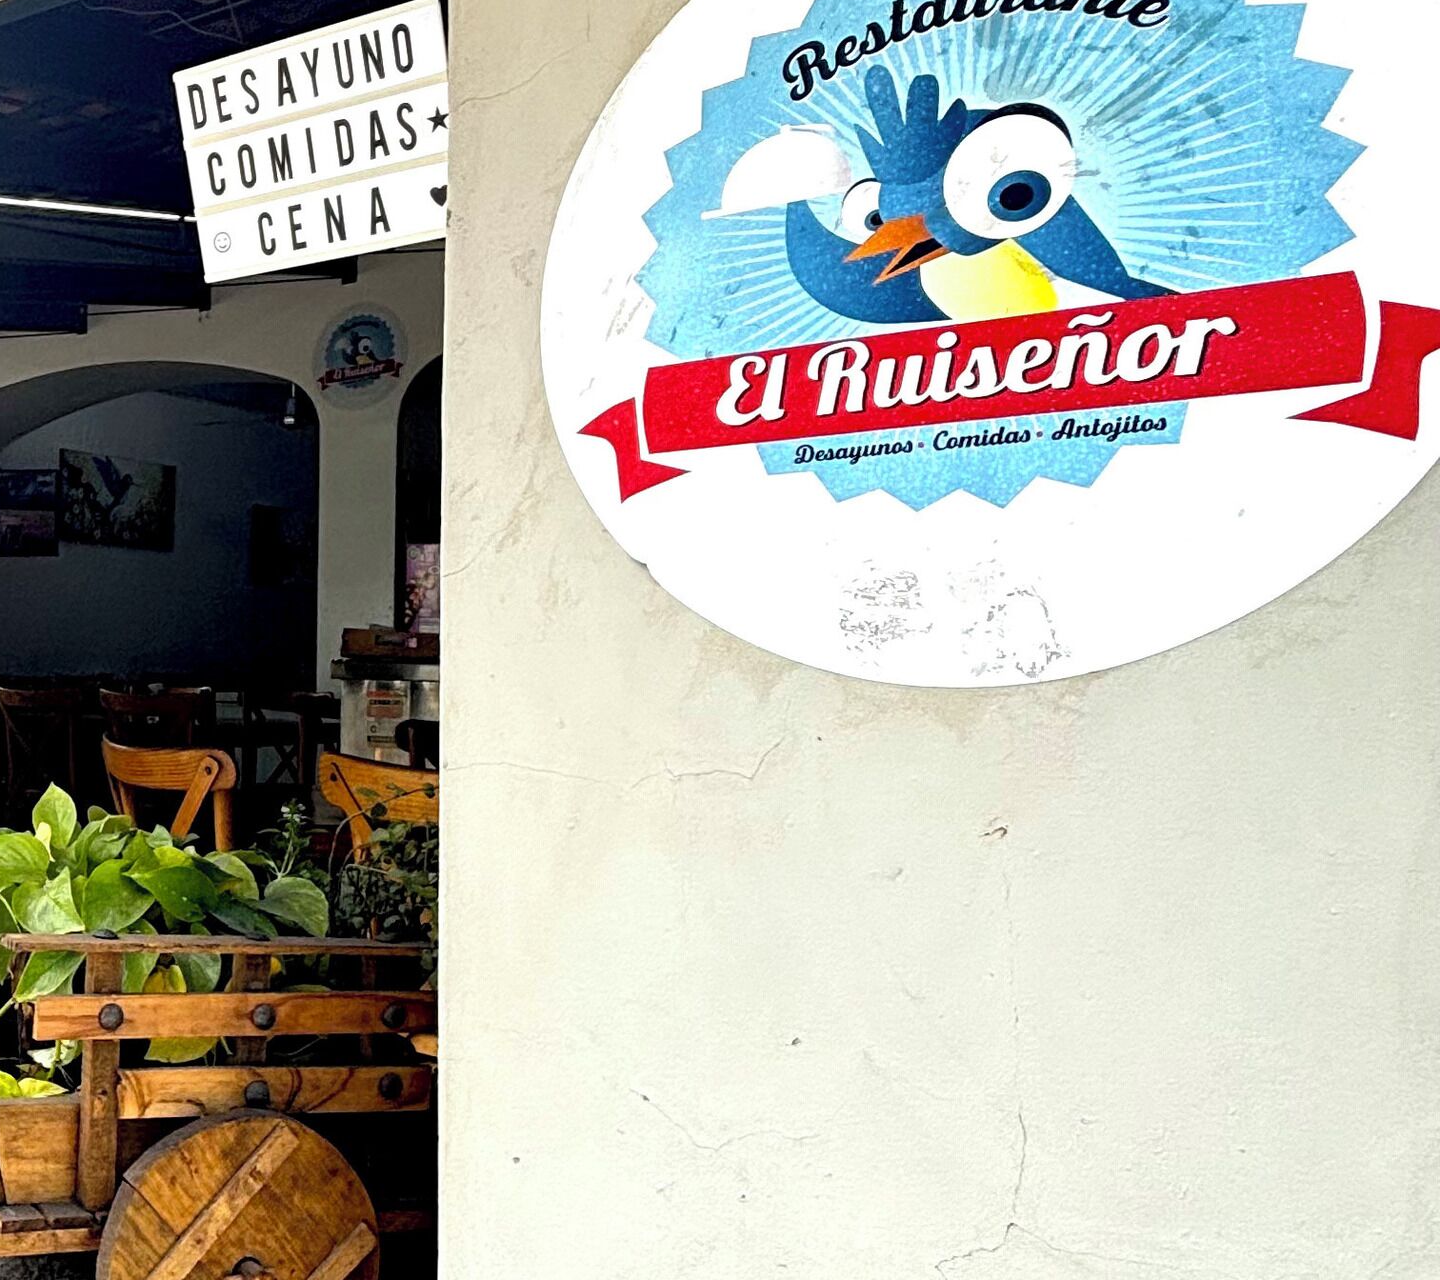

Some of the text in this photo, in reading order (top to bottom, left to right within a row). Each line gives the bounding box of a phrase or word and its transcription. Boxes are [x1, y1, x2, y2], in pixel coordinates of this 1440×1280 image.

[187, 23, 414, 130] DESAYUNO
[207, 102, 417, 196] COMIDAS
[257, 186, 391, 256] CENA
[714, 310, 1238, 427] El Ruiseñor
[794, 415, 1167, 465] Desayunos Comidas Antojitos
